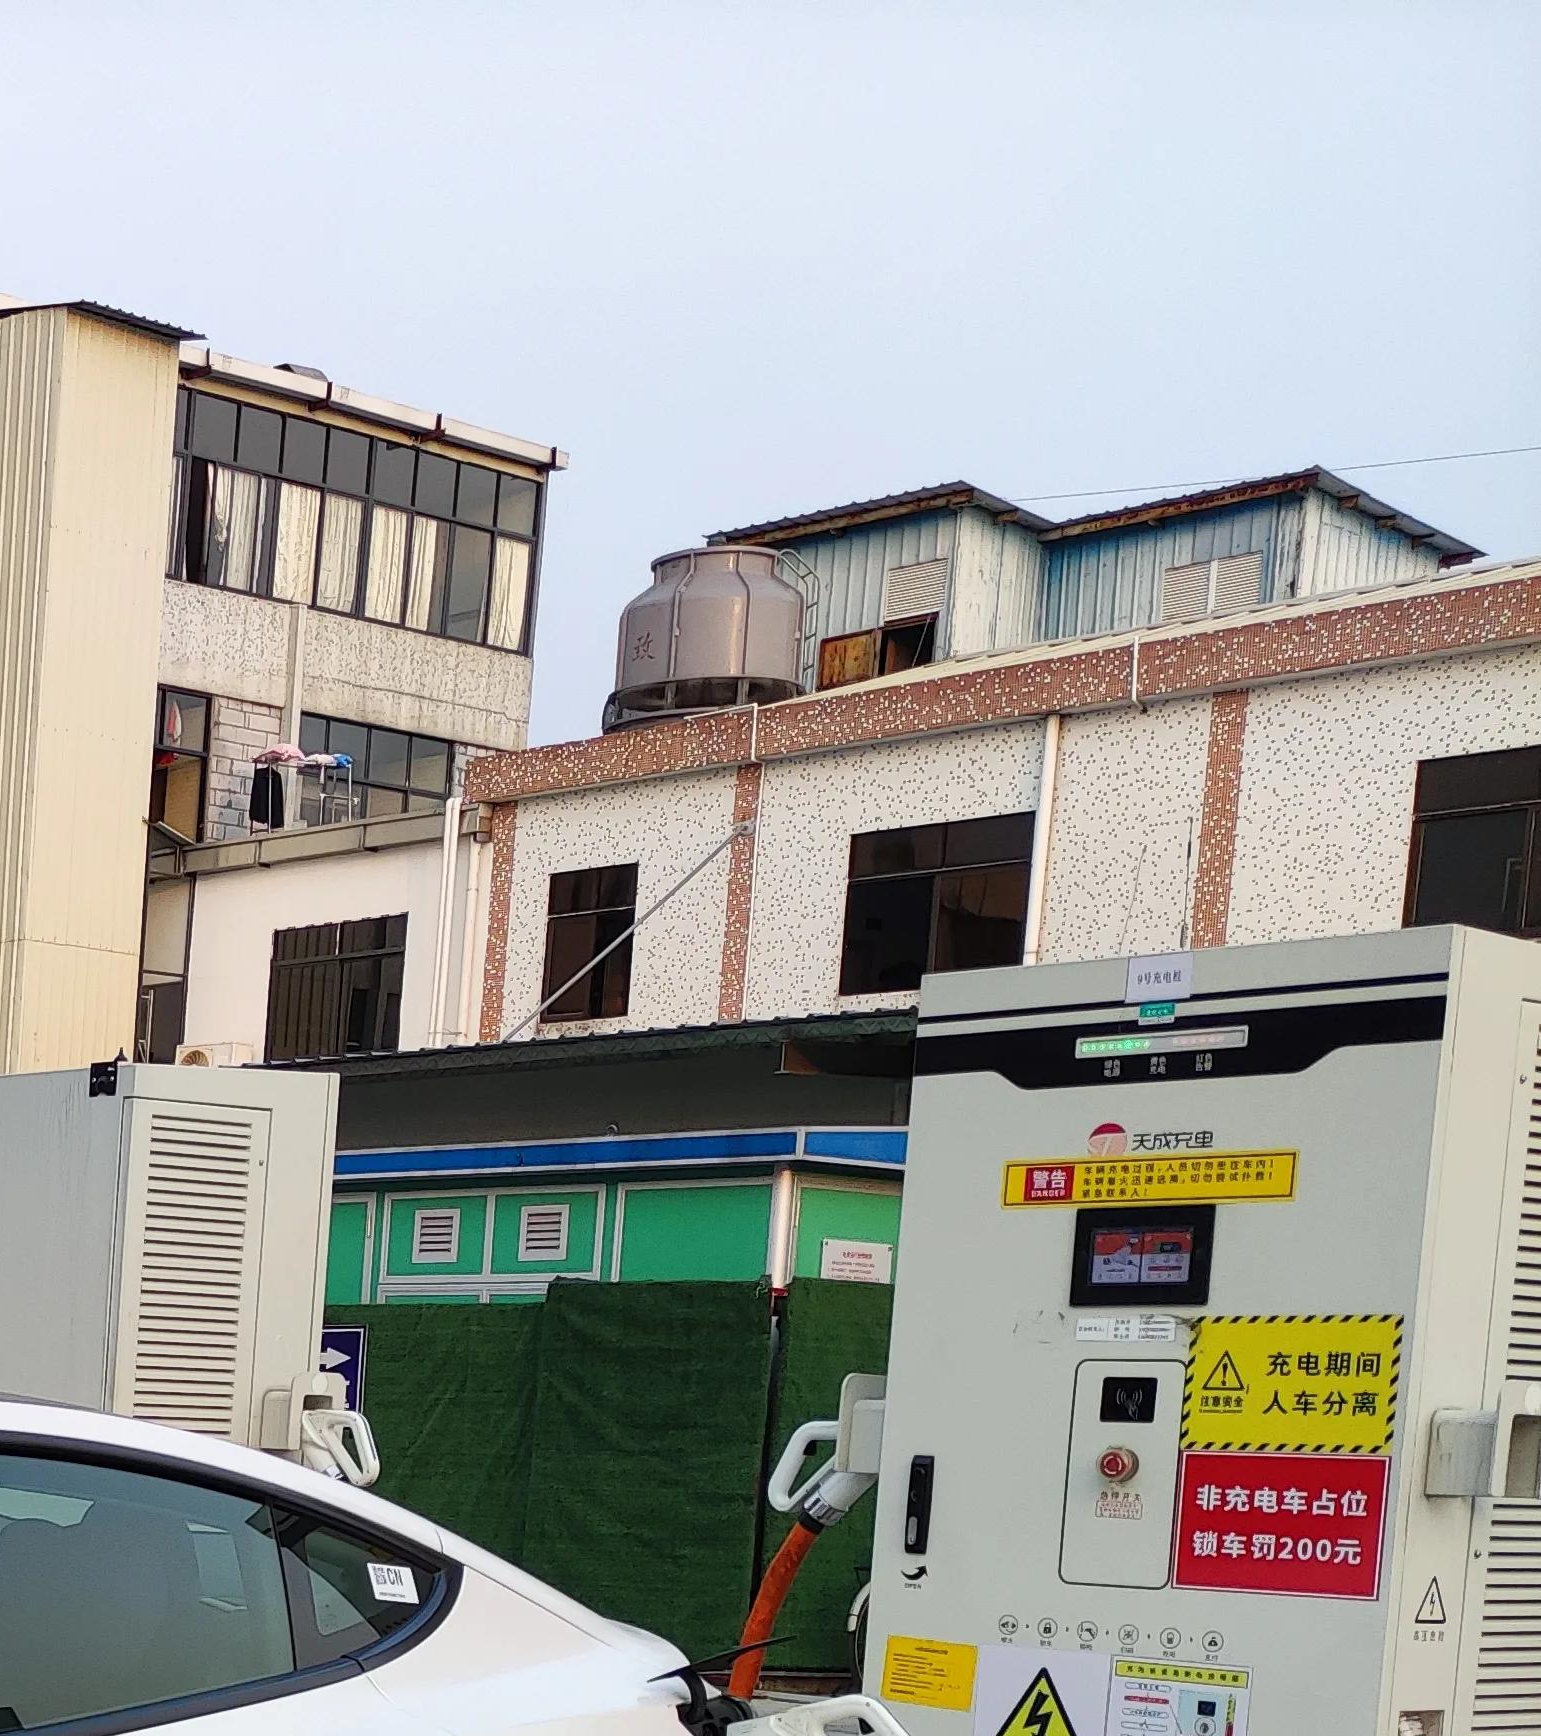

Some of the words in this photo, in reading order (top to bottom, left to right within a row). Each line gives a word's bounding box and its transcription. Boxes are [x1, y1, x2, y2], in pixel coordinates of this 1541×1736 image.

[1131, 1131, 1214, 1151] 天成充电
[1032, 1168, 1066, 1189] 警告
[1266, 1351, 1382, 1378] 充电期间
[1262, 1390, 1380, 1417] 人车分离
[1195, 1484, 1368, 1517] 非充电车占位
[1192, 1530, 1362, 1565] 锁车罚200元
[386, 1568, 404, 1586] CN
